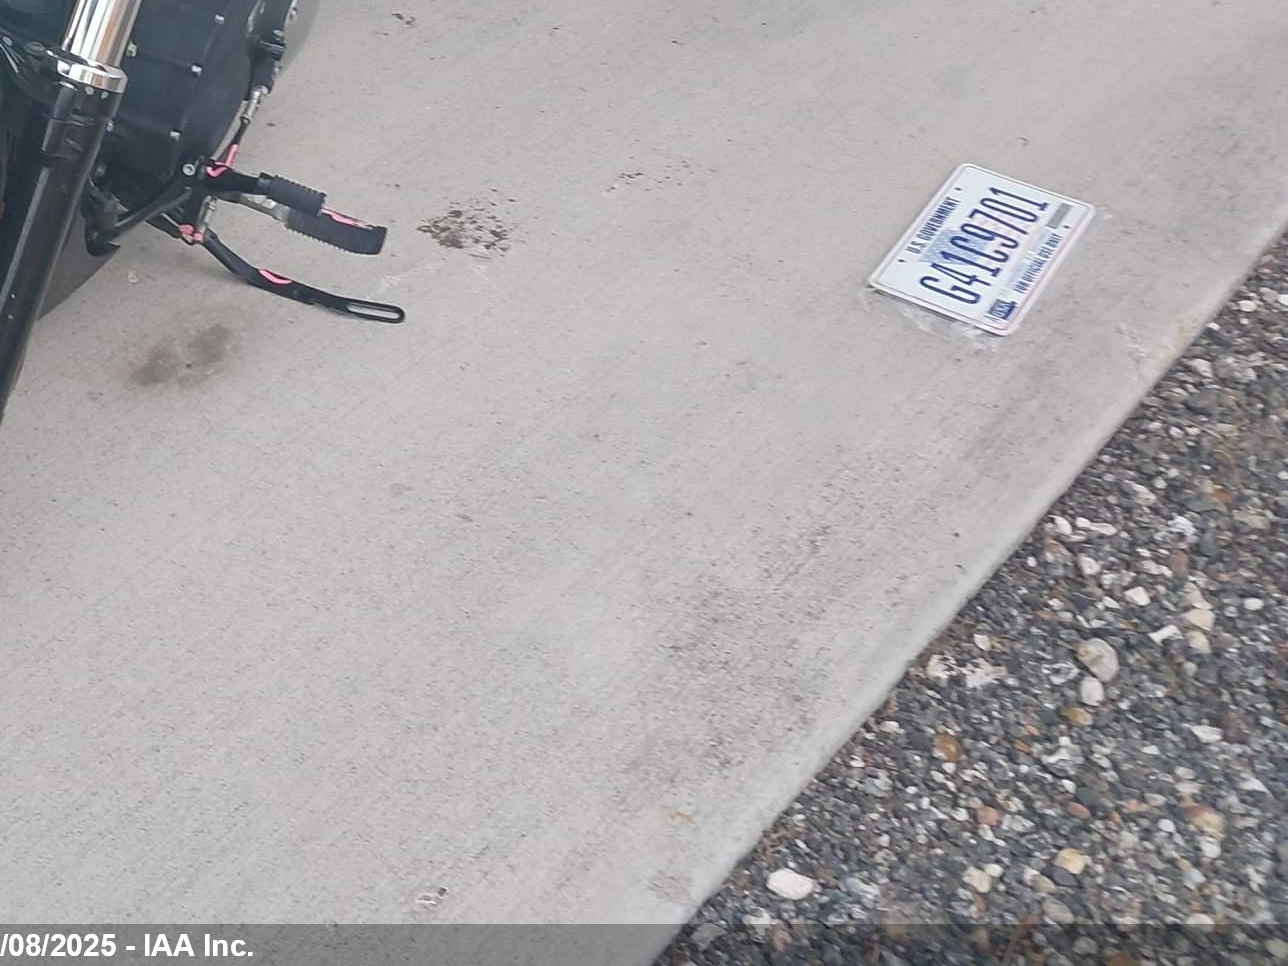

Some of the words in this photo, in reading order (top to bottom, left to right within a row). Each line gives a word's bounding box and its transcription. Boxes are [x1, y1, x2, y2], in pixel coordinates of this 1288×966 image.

[905, 239, 927, 254] U.S.
[917, 196, 961, 241] GOVERNMENT
[919, 186, 1048, 305] G41C9701
